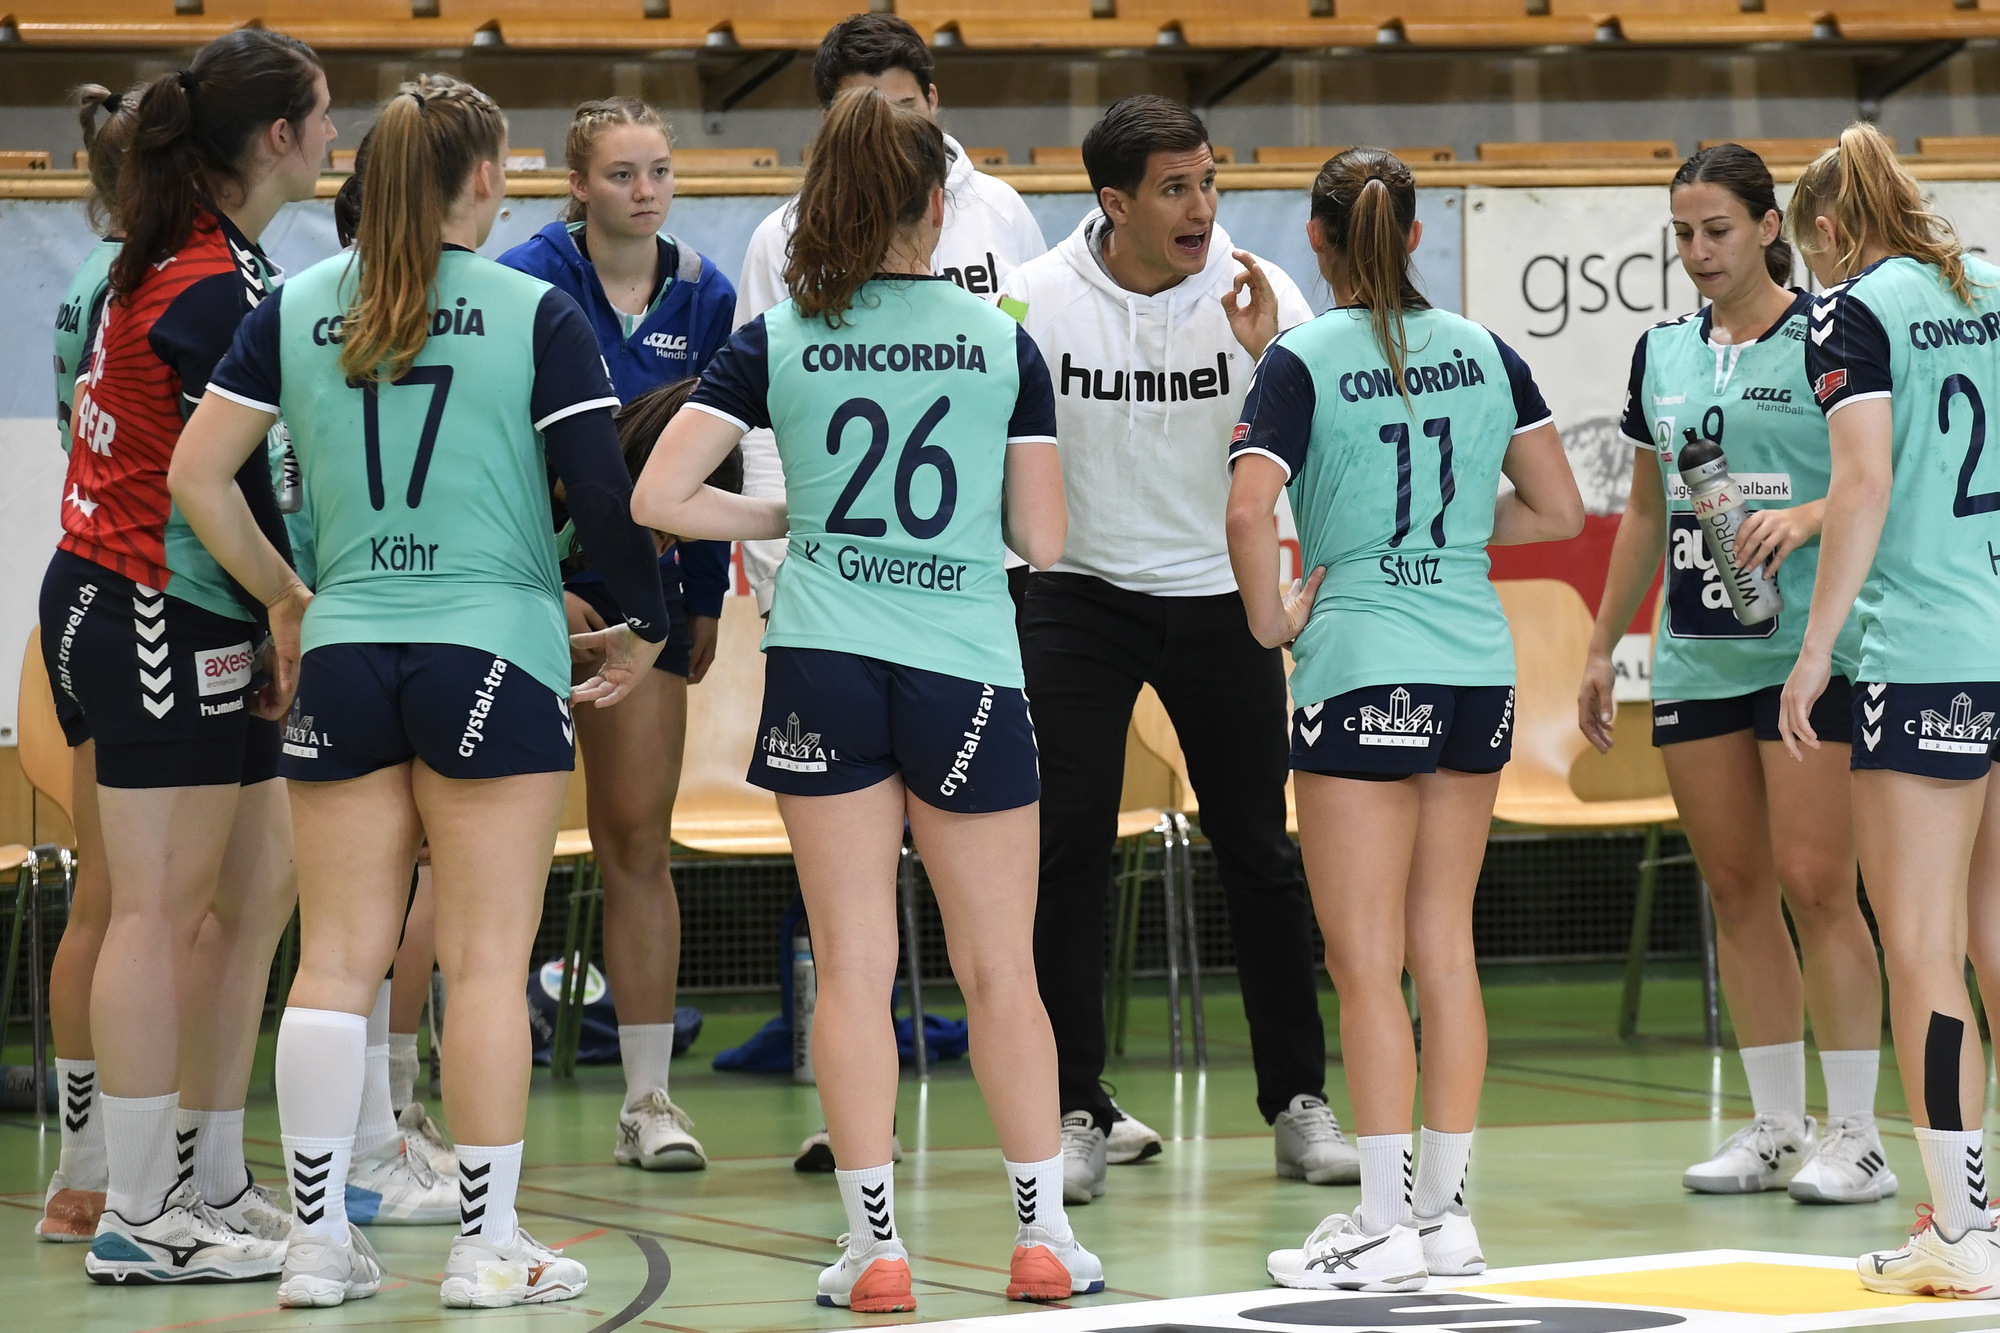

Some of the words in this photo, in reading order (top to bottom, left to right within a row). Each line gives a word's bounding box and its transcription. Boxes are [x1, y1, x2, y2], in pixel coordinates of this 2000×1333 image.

[1521, 226, 1706, 338] gsch
[313, 297, 486, 346] CODiA
[1909, 311, 2000, 351] CONCOR
[656, 348, 699, 360] Handbll
[1756, 402, 1804, 415] Handball
[345, 365, 454, 511] 17
[825, 395, 958, 539] 26
[1378, 416, 1456, 548] 11
[371, 533, 439, 571] Kähr
[1672, 528, 1714, 570] au
[837, 545, 967, 592] Gwerder
[1379, 554, 1443, 586] Stutz
[204, 649, 253, 677] axess
[200, 695, 244, 717] hummel
[1489, 686, 1515, 748] crysta
[940, 683, 995, 797] crystal-trav
[1343, 716, 1443, 735] CRYSTAL
[1364, 737, 1427, 746] TRAVEL
[1904, 719, 2000, 741] CRYSTAL
[762, 735, 841, 762] CRYSTAL
[1924, 742, 1983, 752] TRAVEL
[769, 758, 823, 772] TRAVEL
